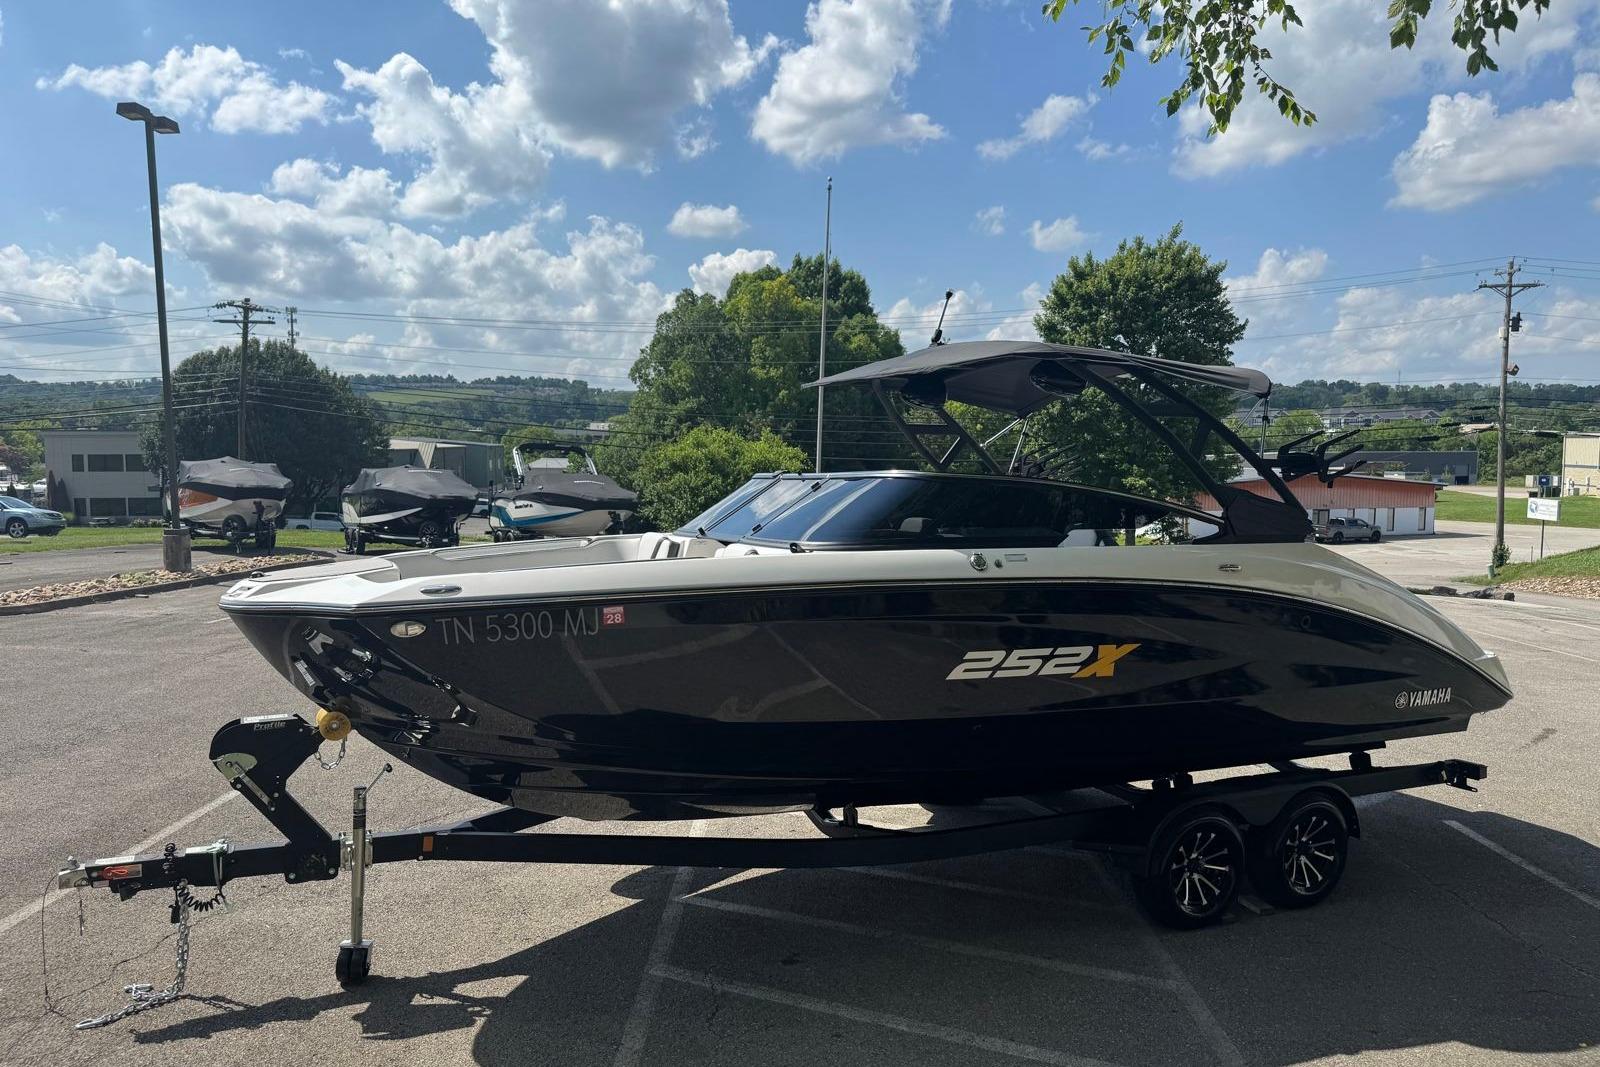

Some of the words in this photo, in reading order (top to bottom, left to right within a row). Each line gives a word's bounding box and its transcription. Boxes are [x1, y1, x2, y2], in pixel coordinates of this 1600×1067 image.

[435, 616, 475, 645] TN
[486, 610, 553, 642] 5300
[564, 607, 600, 637] MJ
[606, 613, 622, 624] 28
[945, 643, 1142, 681] 252X
[1409, 687, 1452, 708] YAMAHA
